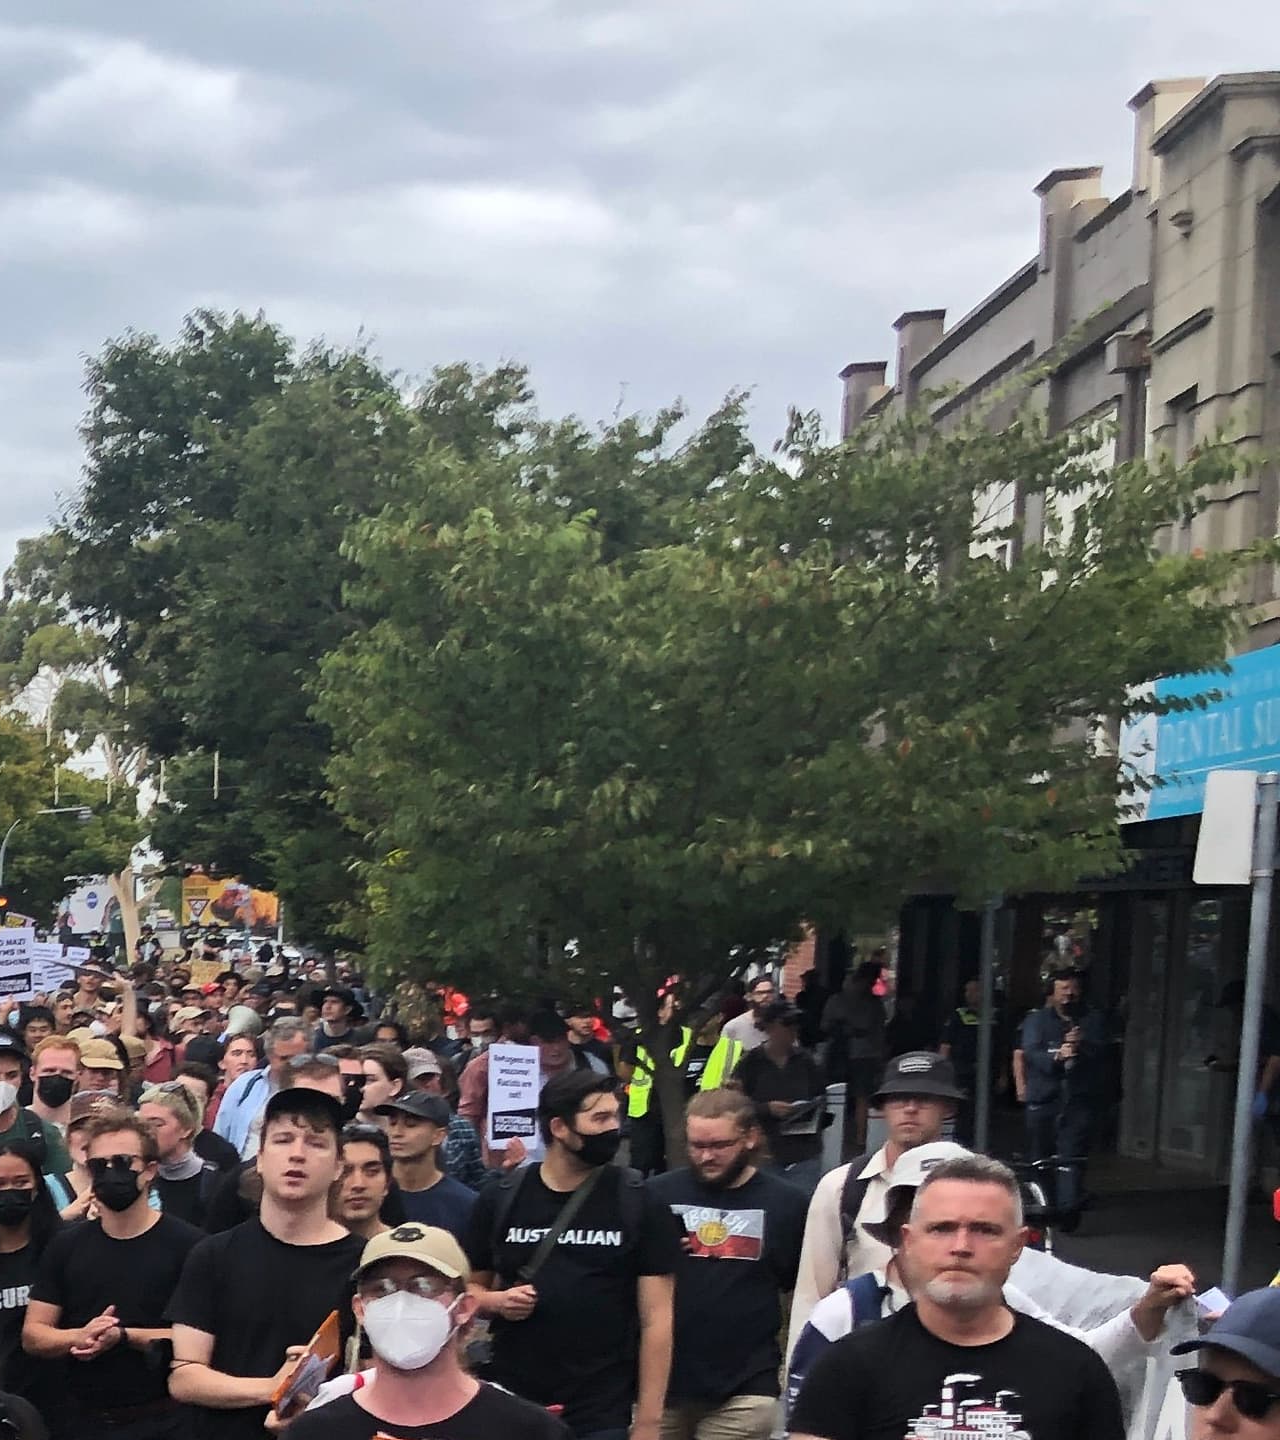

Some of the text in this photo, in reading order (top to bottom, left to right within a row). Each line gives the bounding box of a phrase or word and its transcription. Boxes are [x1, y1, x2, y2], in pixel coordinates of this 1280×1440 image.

[1158, 705, 1243, 767] DENTAL
[16, 948, 26, 956] IN
[505, 1226, 622, 1247] AUSTALIAN
